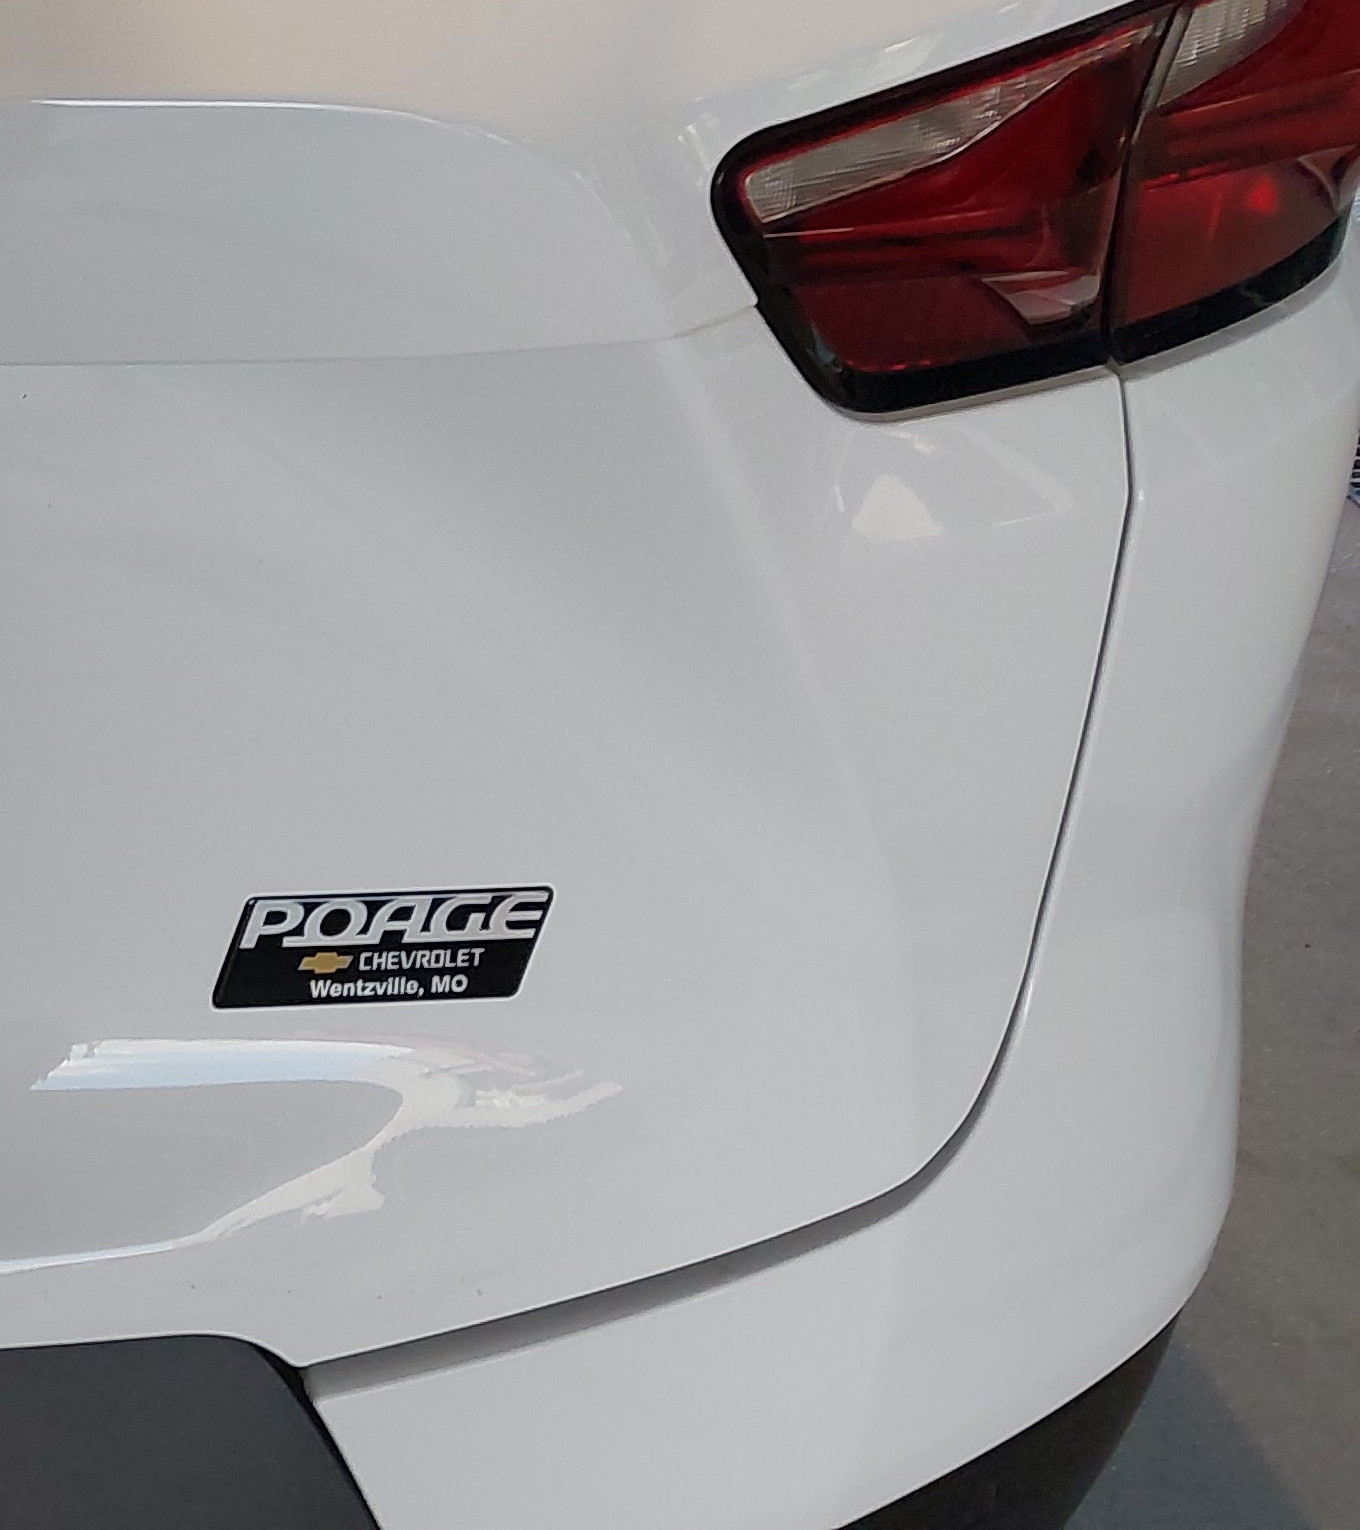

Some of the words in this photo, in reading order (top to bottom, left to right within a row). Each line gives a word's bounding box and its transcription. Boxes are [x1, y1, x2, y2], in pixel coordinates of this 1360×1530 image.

[239, 890, 550, 949] POAGE
[358, 948, 485, 972] CHEVROLET
[310, 975, 424, 999] Wentzville,
[431, 974, 468, 994] MO
